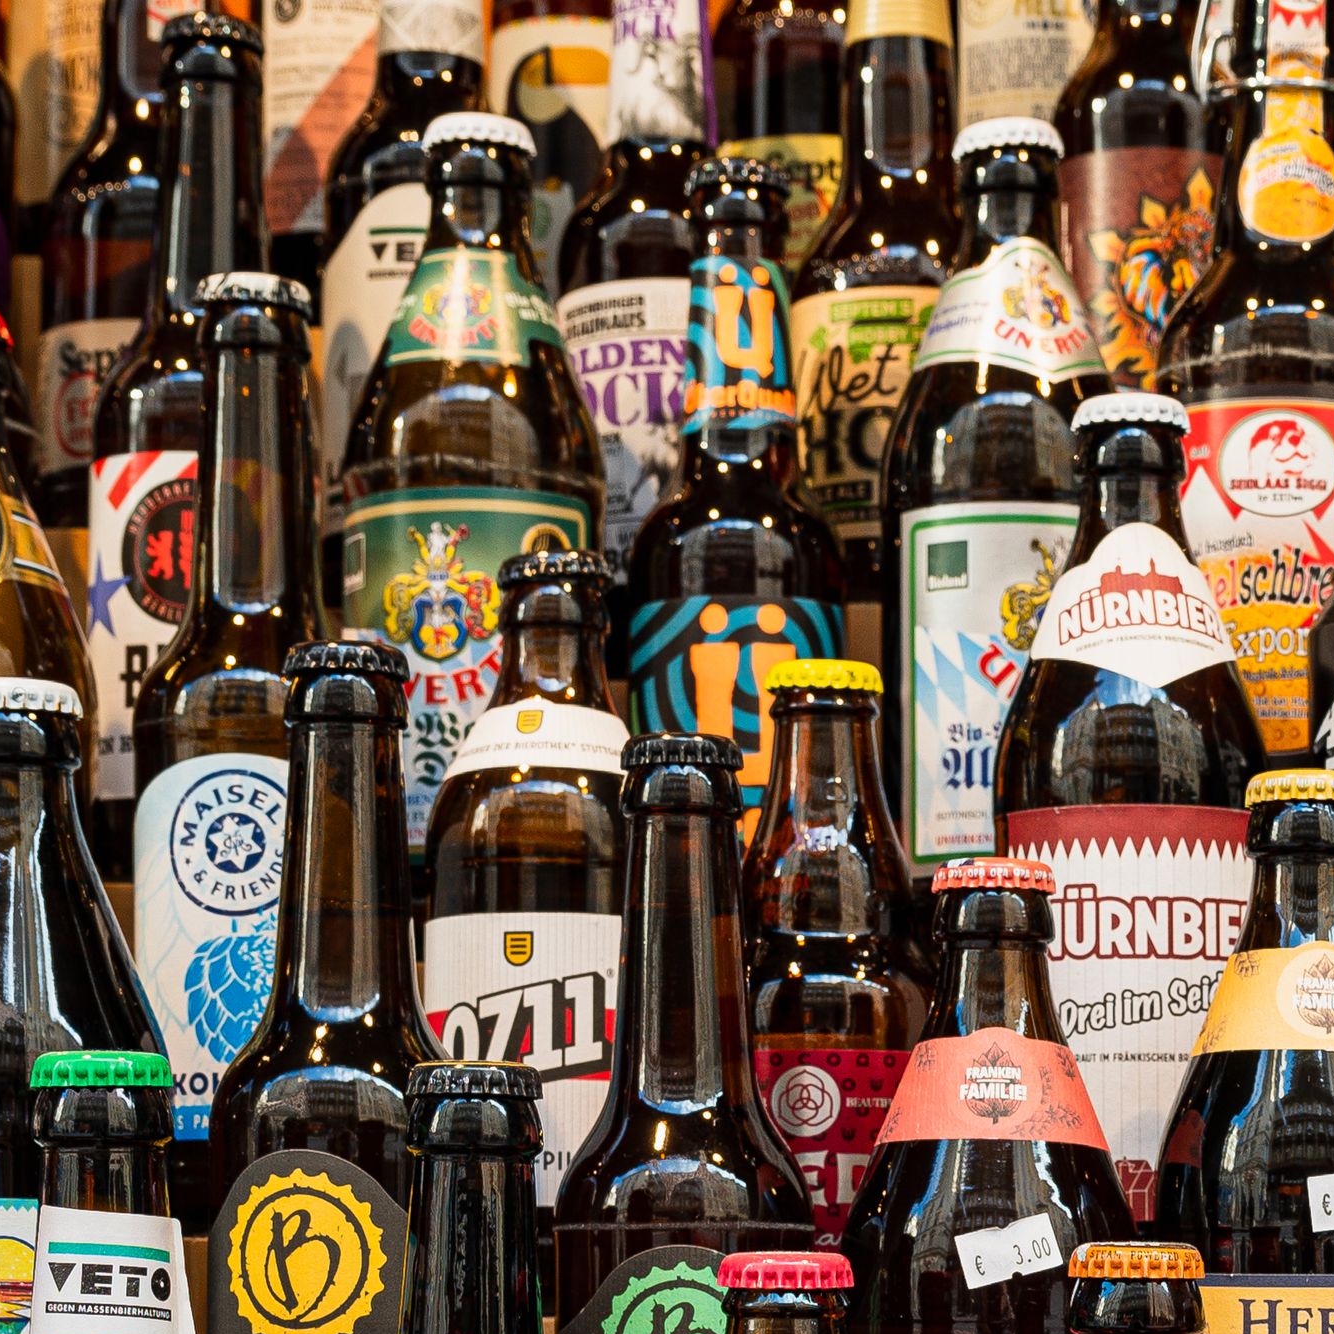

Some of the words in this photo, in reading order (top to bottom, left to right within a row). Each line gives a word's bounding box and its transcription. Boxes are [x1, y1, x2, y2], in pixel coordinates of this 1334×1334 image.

[1058, 585, 1227, 650] NÜRNBIER
[443, 973, 608, 1070] 0711
[1058, 996, 1115, 1039] Drei
[1120, 994, 1163, 1028] im
[1168, 973, 1224, 1016] Seid
[959, 1084, 1028, 1101] FAMILIE!
[966, 1067, 1022, 1081] FRANKEN
[1322, 1193, 1332, 1216] €
[974, 1254, 986, 1277] €
[1014, 1236, 1053, 1266] 3.00
[48, 1261, 172, 1302] VETO
[47, 1303, 74, 1314] GEGEN
[77, 1304, 172, 1321] MASSENBIERHALTUNG
